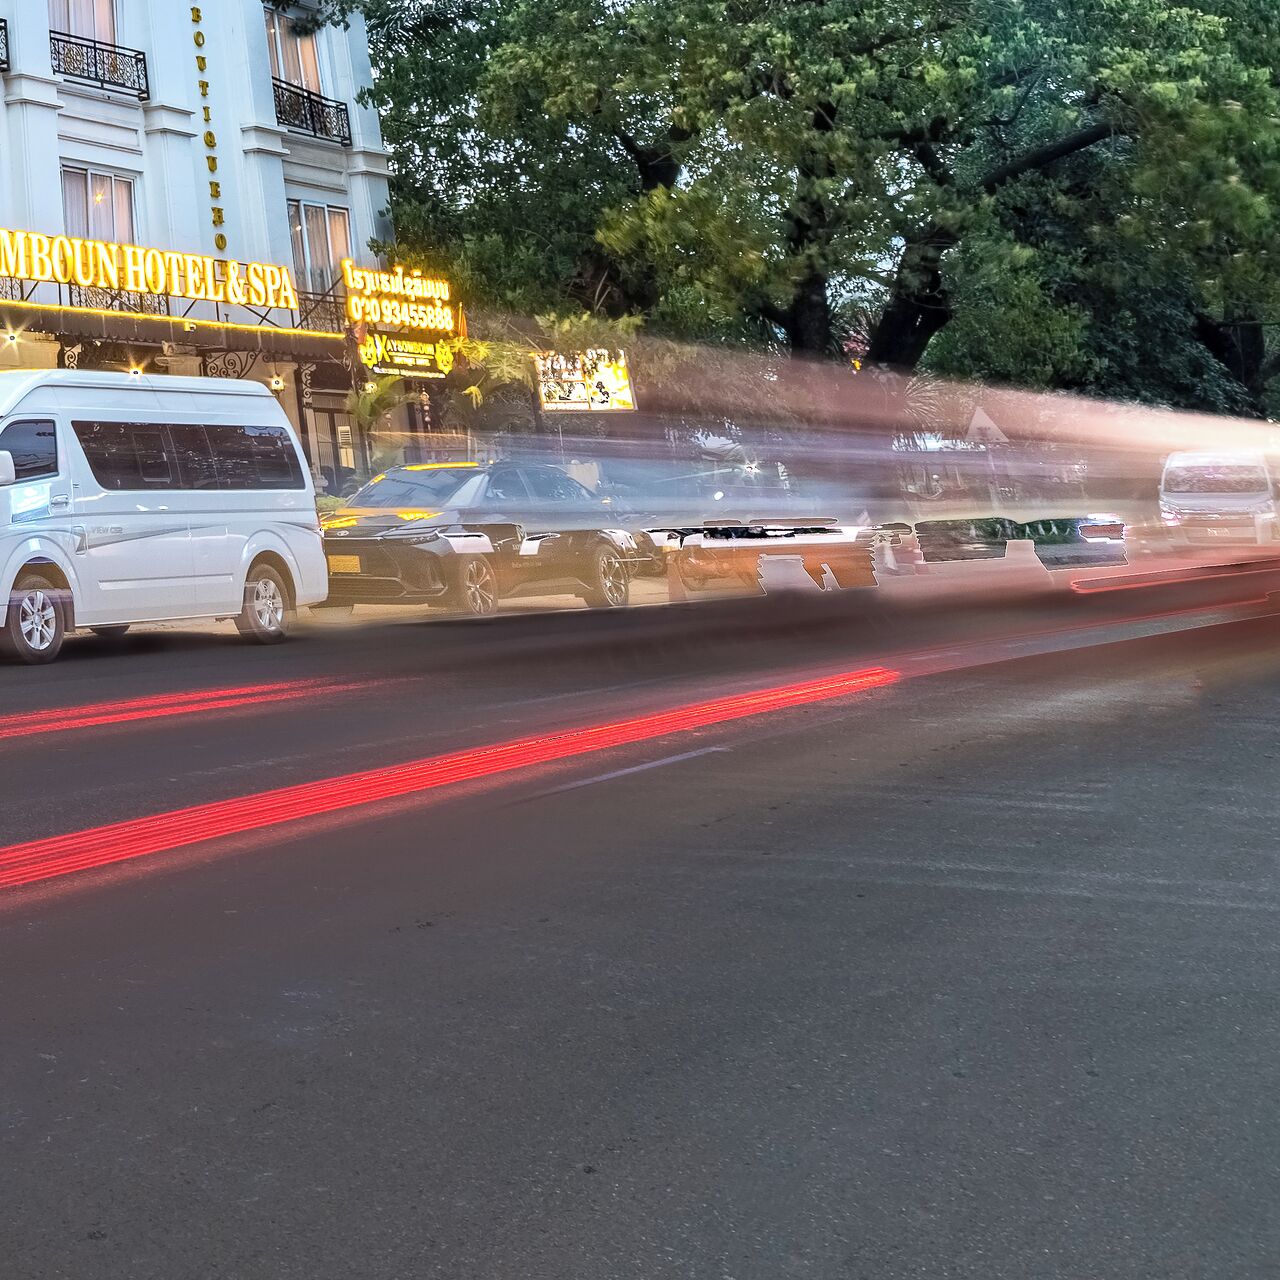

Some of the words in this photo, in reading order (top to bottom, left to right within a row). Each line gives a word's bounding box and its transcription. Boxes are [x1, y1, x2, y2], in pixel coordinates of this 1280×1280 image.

[122, 245, 226, 302] HOTEL
[226, 259, 248, 305] &
[247, 260, 299, 310] SPA
[381, 299, 454, 331] 93455888
